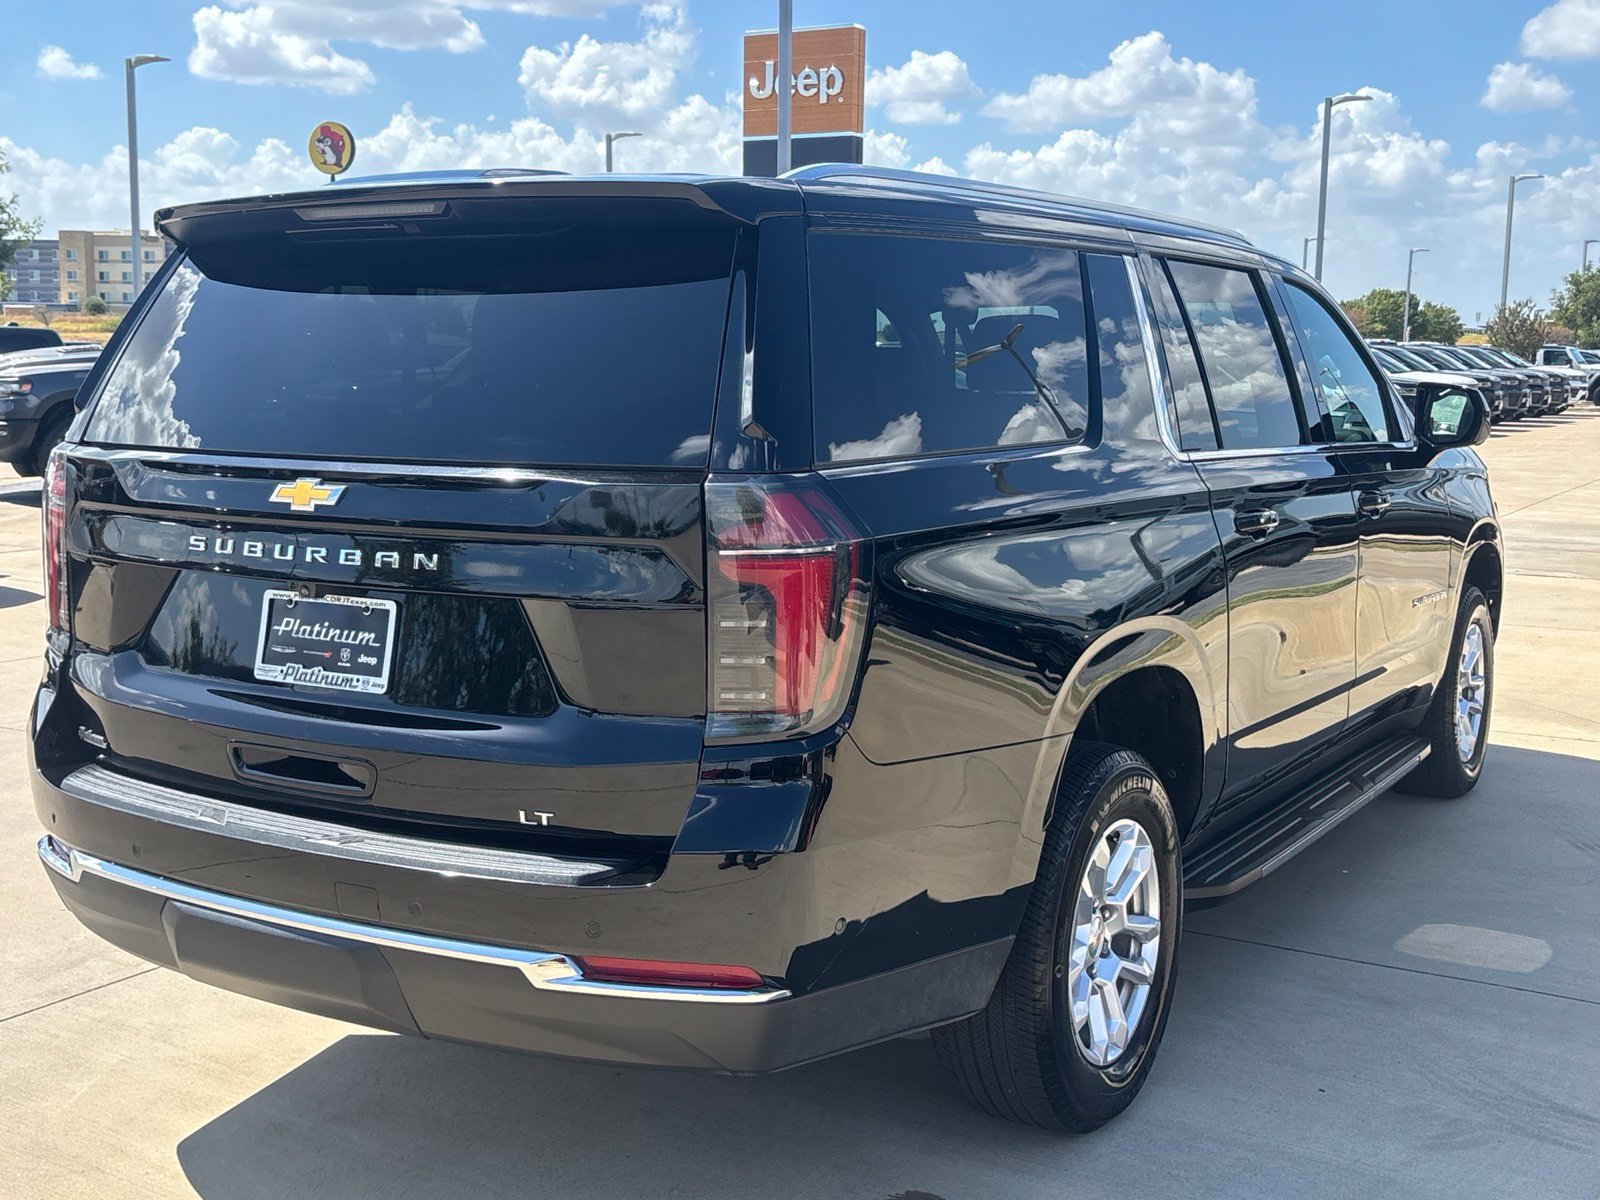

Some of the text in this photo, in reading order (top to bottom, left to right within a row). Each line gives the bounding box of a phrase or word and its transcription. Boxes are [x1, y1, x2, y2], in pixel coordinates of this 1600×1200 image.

[188, 535, 439, 571] SUBURBAN
[272, 591, 387, 608] www.PCDRJTexas.com
[272, 617, 380, 647] Platinum
[357, 653, 378, 666] Jeep
[282, 664, 359, 689] Platinum
[1110, 776, 1152, 804] MICHELIN
[518, 809, 555, 826] LT
